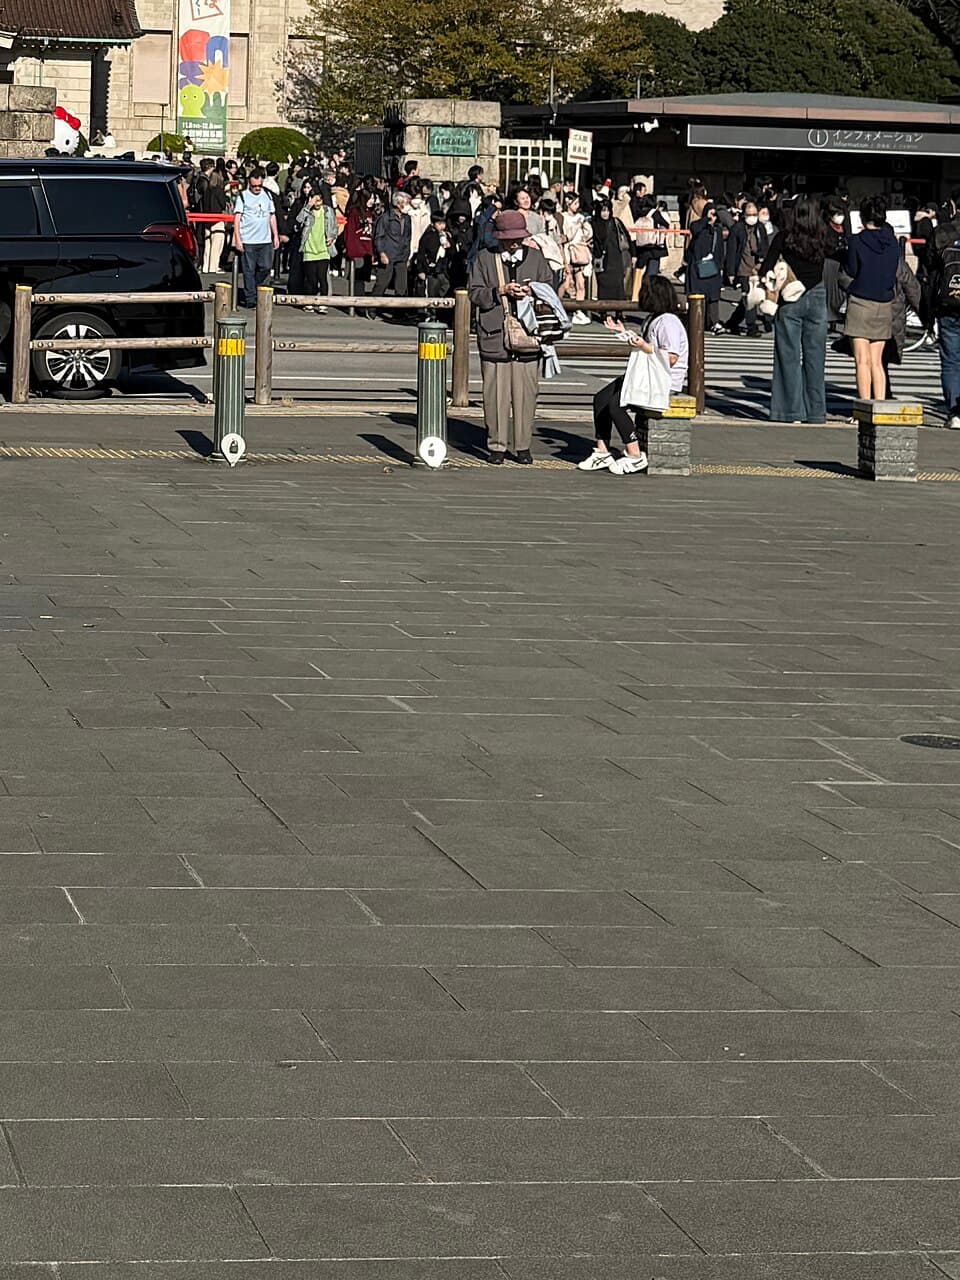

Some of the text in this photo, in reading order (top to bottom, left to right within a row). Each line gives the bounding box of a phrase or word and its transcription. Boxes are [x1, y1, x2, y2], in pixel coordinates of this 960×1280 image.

[832, 130, 924, 143] インフォメーション
